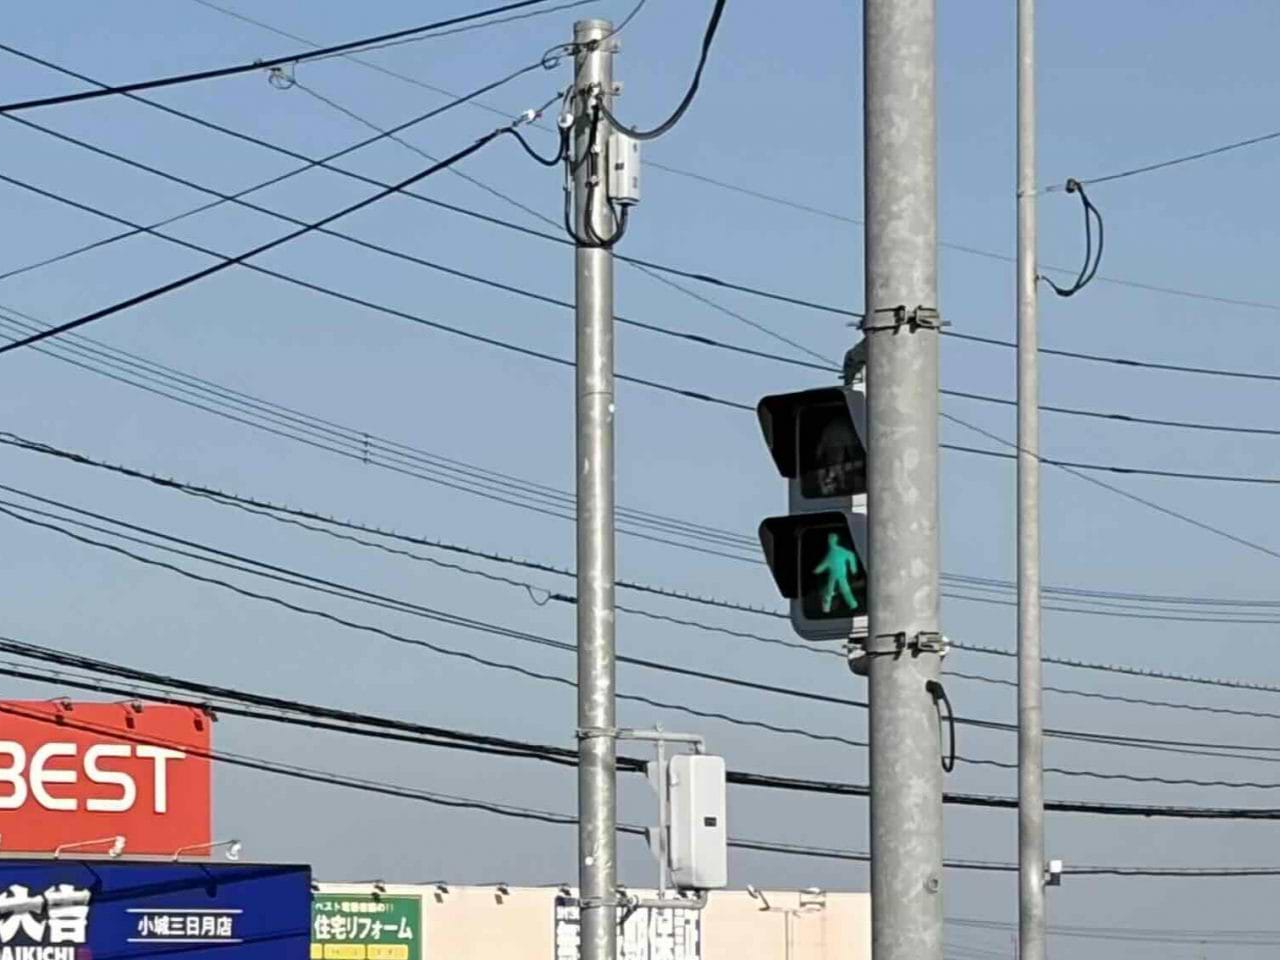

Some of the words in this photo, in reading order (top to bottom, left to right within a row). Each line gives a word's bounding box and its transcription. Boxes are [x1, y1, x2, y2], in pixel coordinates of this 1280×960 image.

[138, 915, 232, 937] 小城三日月店
[314, 914, 413, 940] 住宅リフォーム
